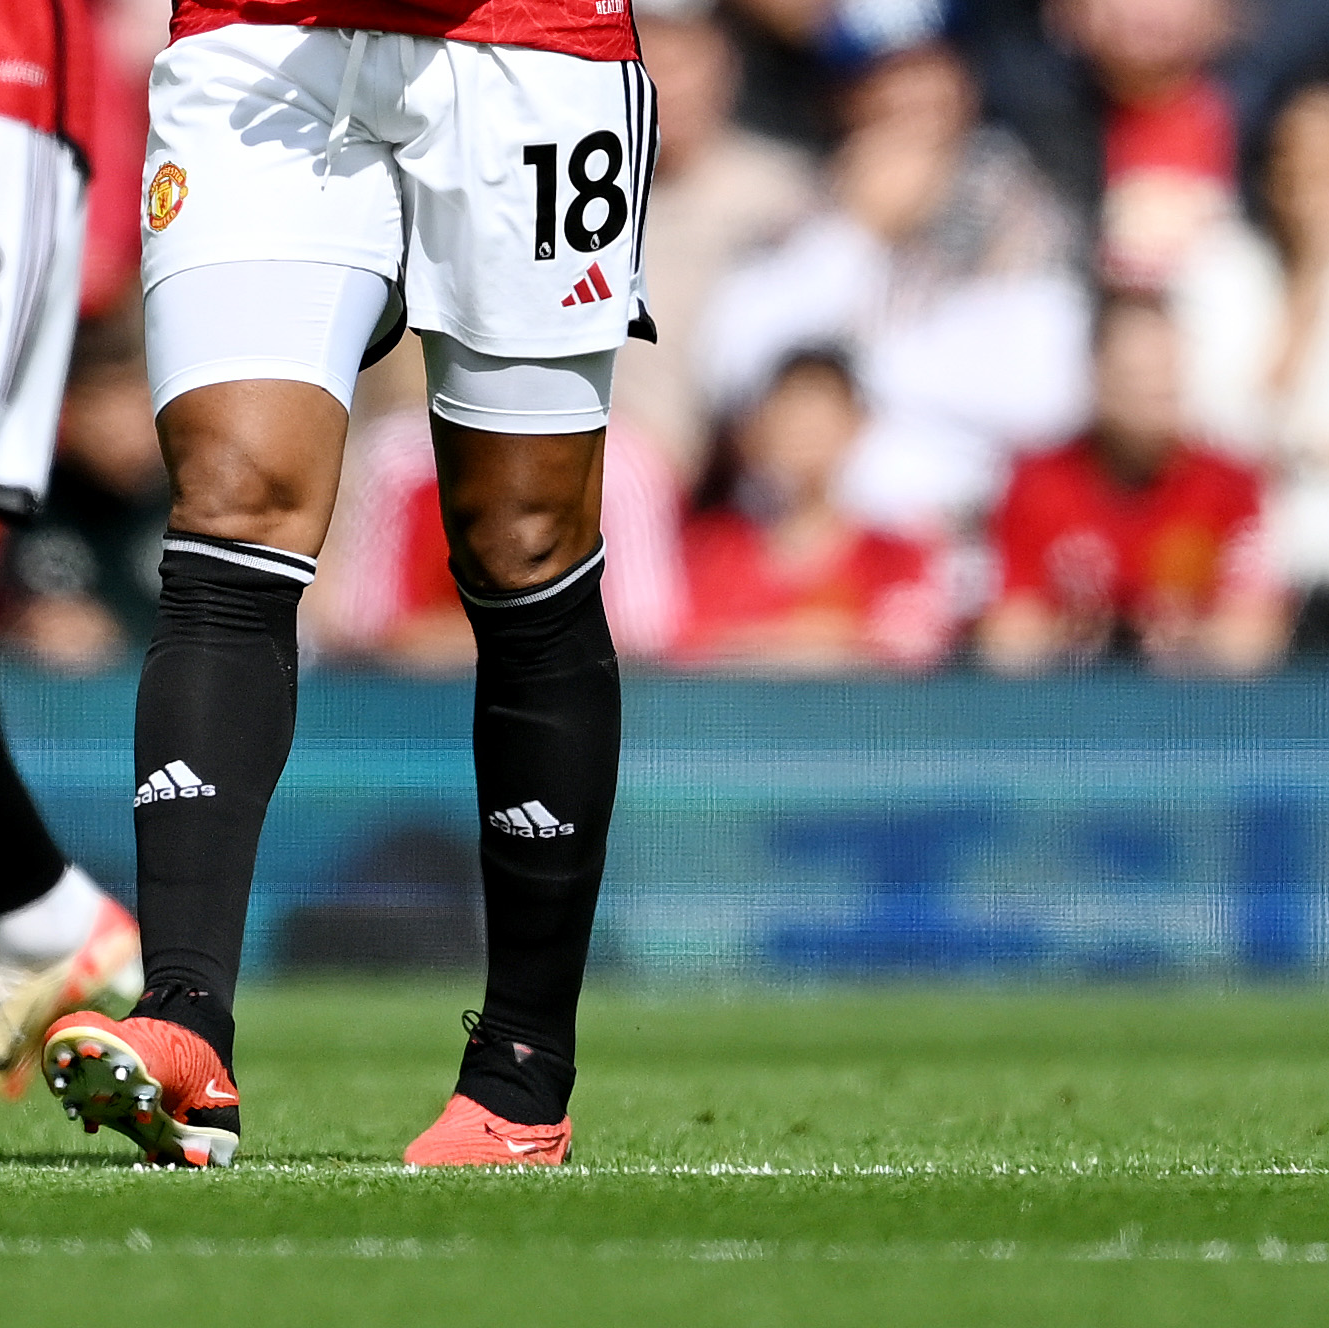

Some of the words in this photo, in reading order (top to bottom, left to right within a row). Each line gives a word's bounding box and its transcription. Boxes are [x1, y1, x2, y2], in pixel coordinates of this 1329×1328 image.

[523, 130, 628, 261] 18
[133, 784, 217, 808] adidas
[488, 815, 575, 839] adidas
